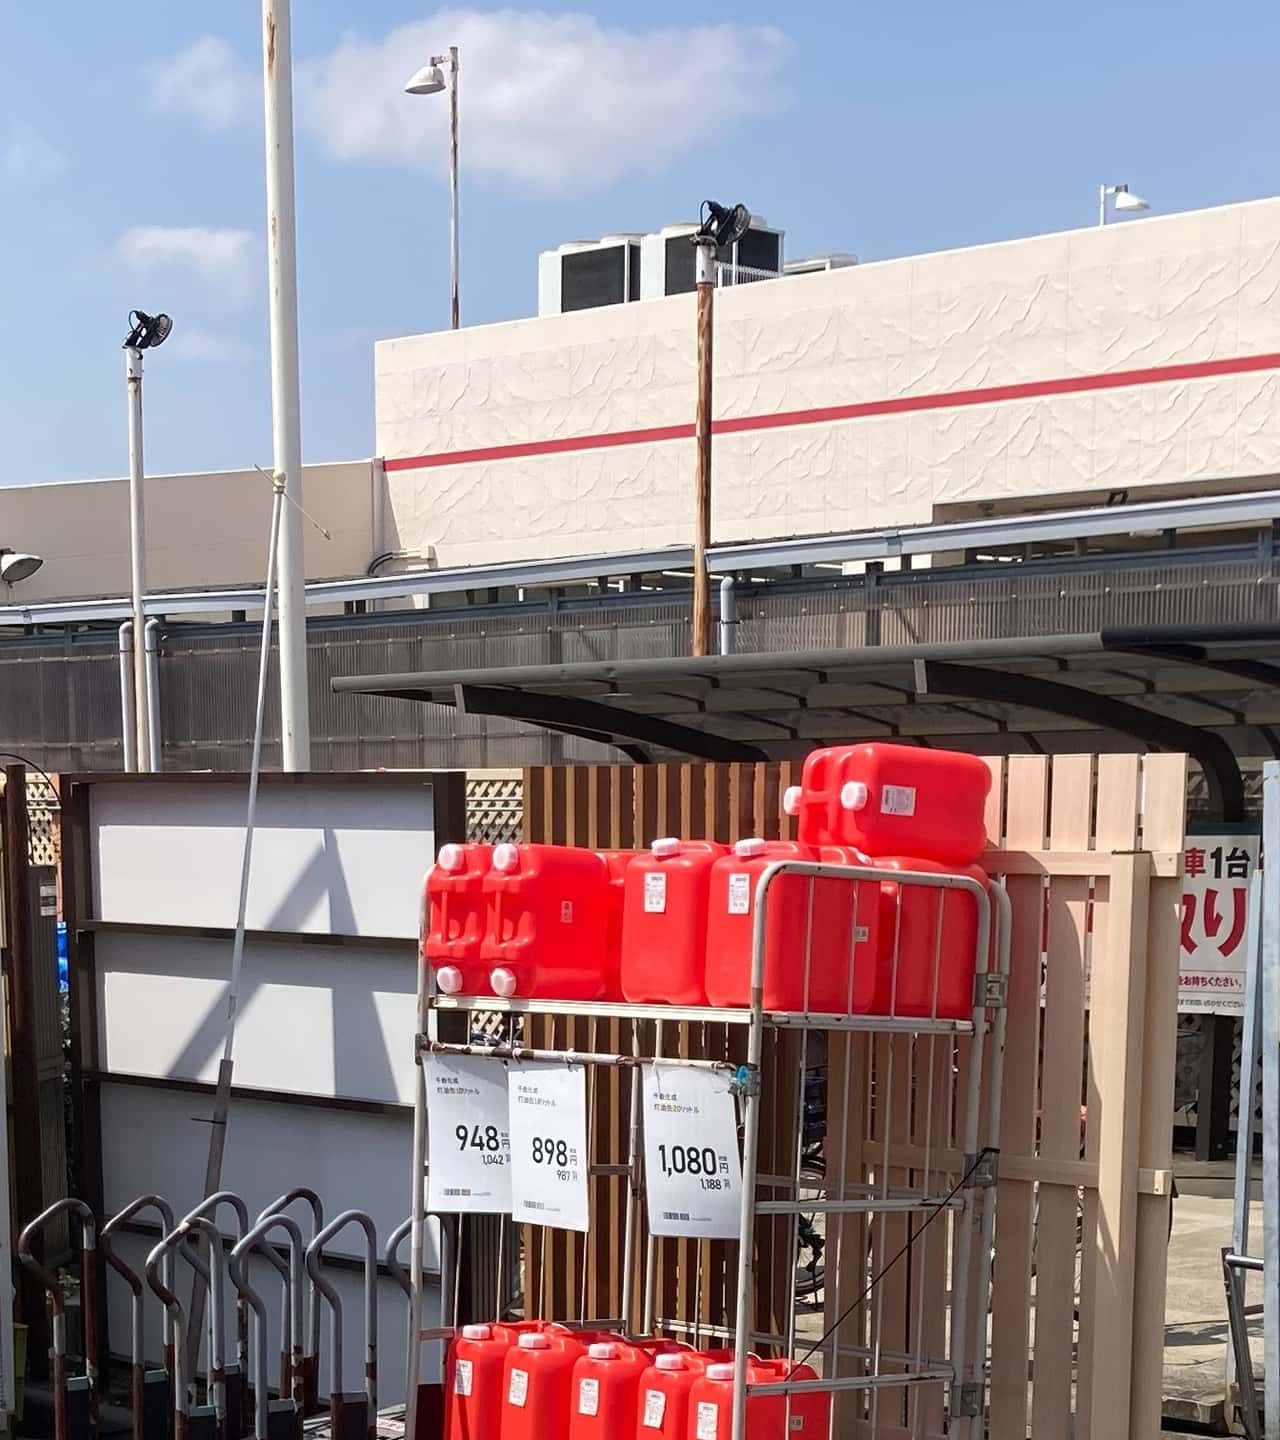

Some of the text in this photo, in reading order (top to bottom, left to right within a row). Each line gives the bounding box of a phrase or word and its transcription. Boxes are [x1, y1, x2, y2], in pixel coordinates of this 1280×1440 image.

[455, 1124, 500, 1151] 948
[481, 1154, 504, 1167] 1,042
[532, 1136, 568, 1167] 898
[658, 1144, 717, 1178] 1,080
[700, 1178, 722, 1190] 1,188
